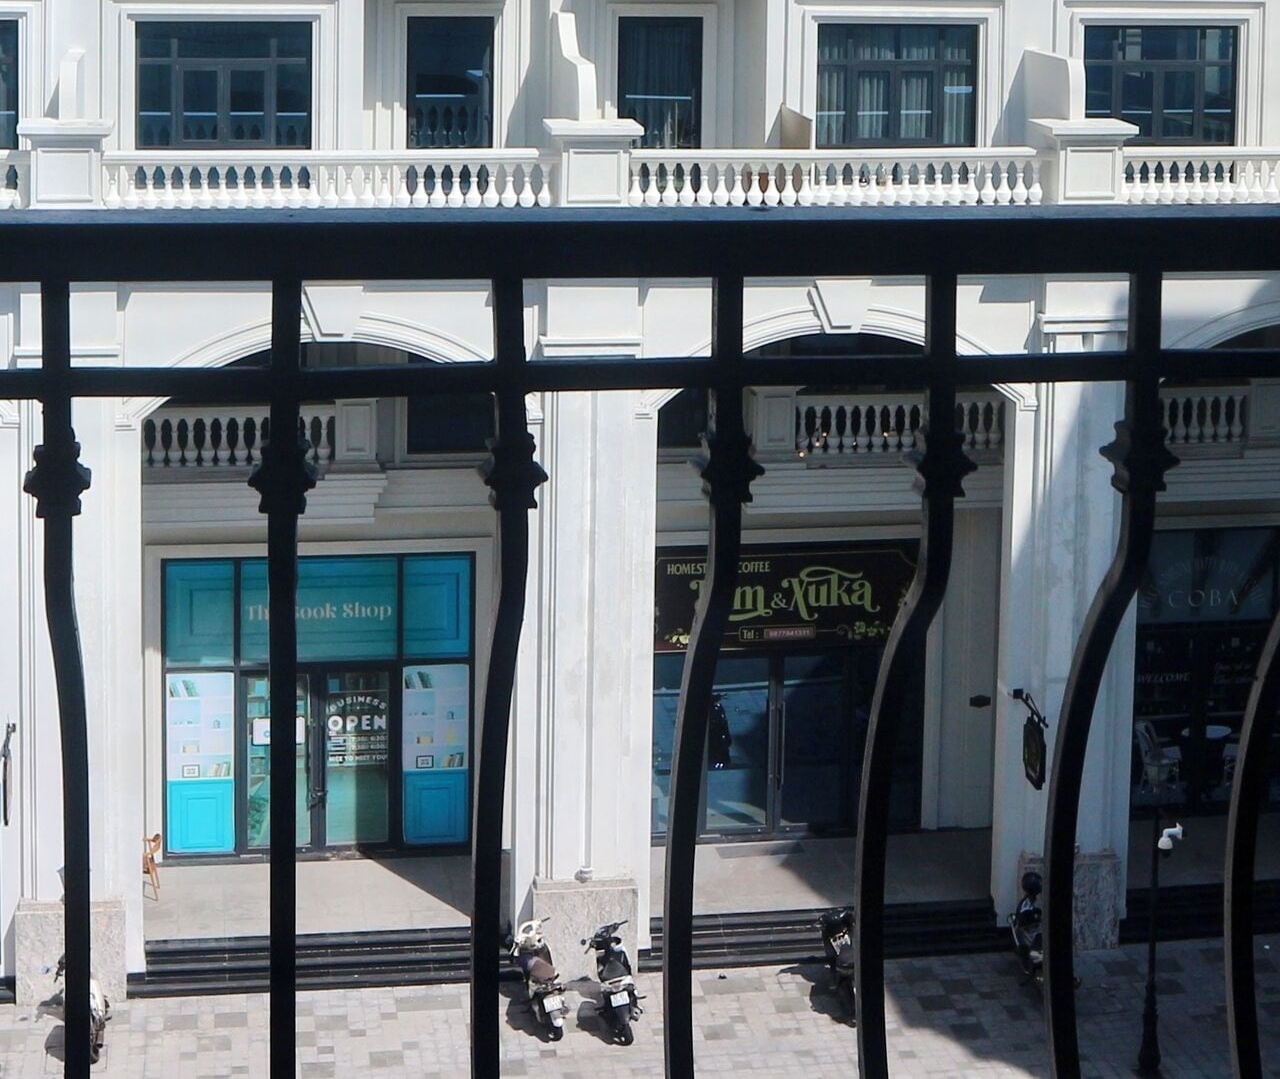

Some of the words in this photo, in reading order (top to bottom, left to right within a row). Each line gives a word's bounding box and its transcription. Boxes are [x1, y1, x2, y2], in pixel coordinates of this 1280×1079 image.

[781, 566, 880, 620] Xuka
[295, 603, 337, 619] ook
[342, 602, 392, 621] Shop
[327, 715, 387, 731] OPEN
